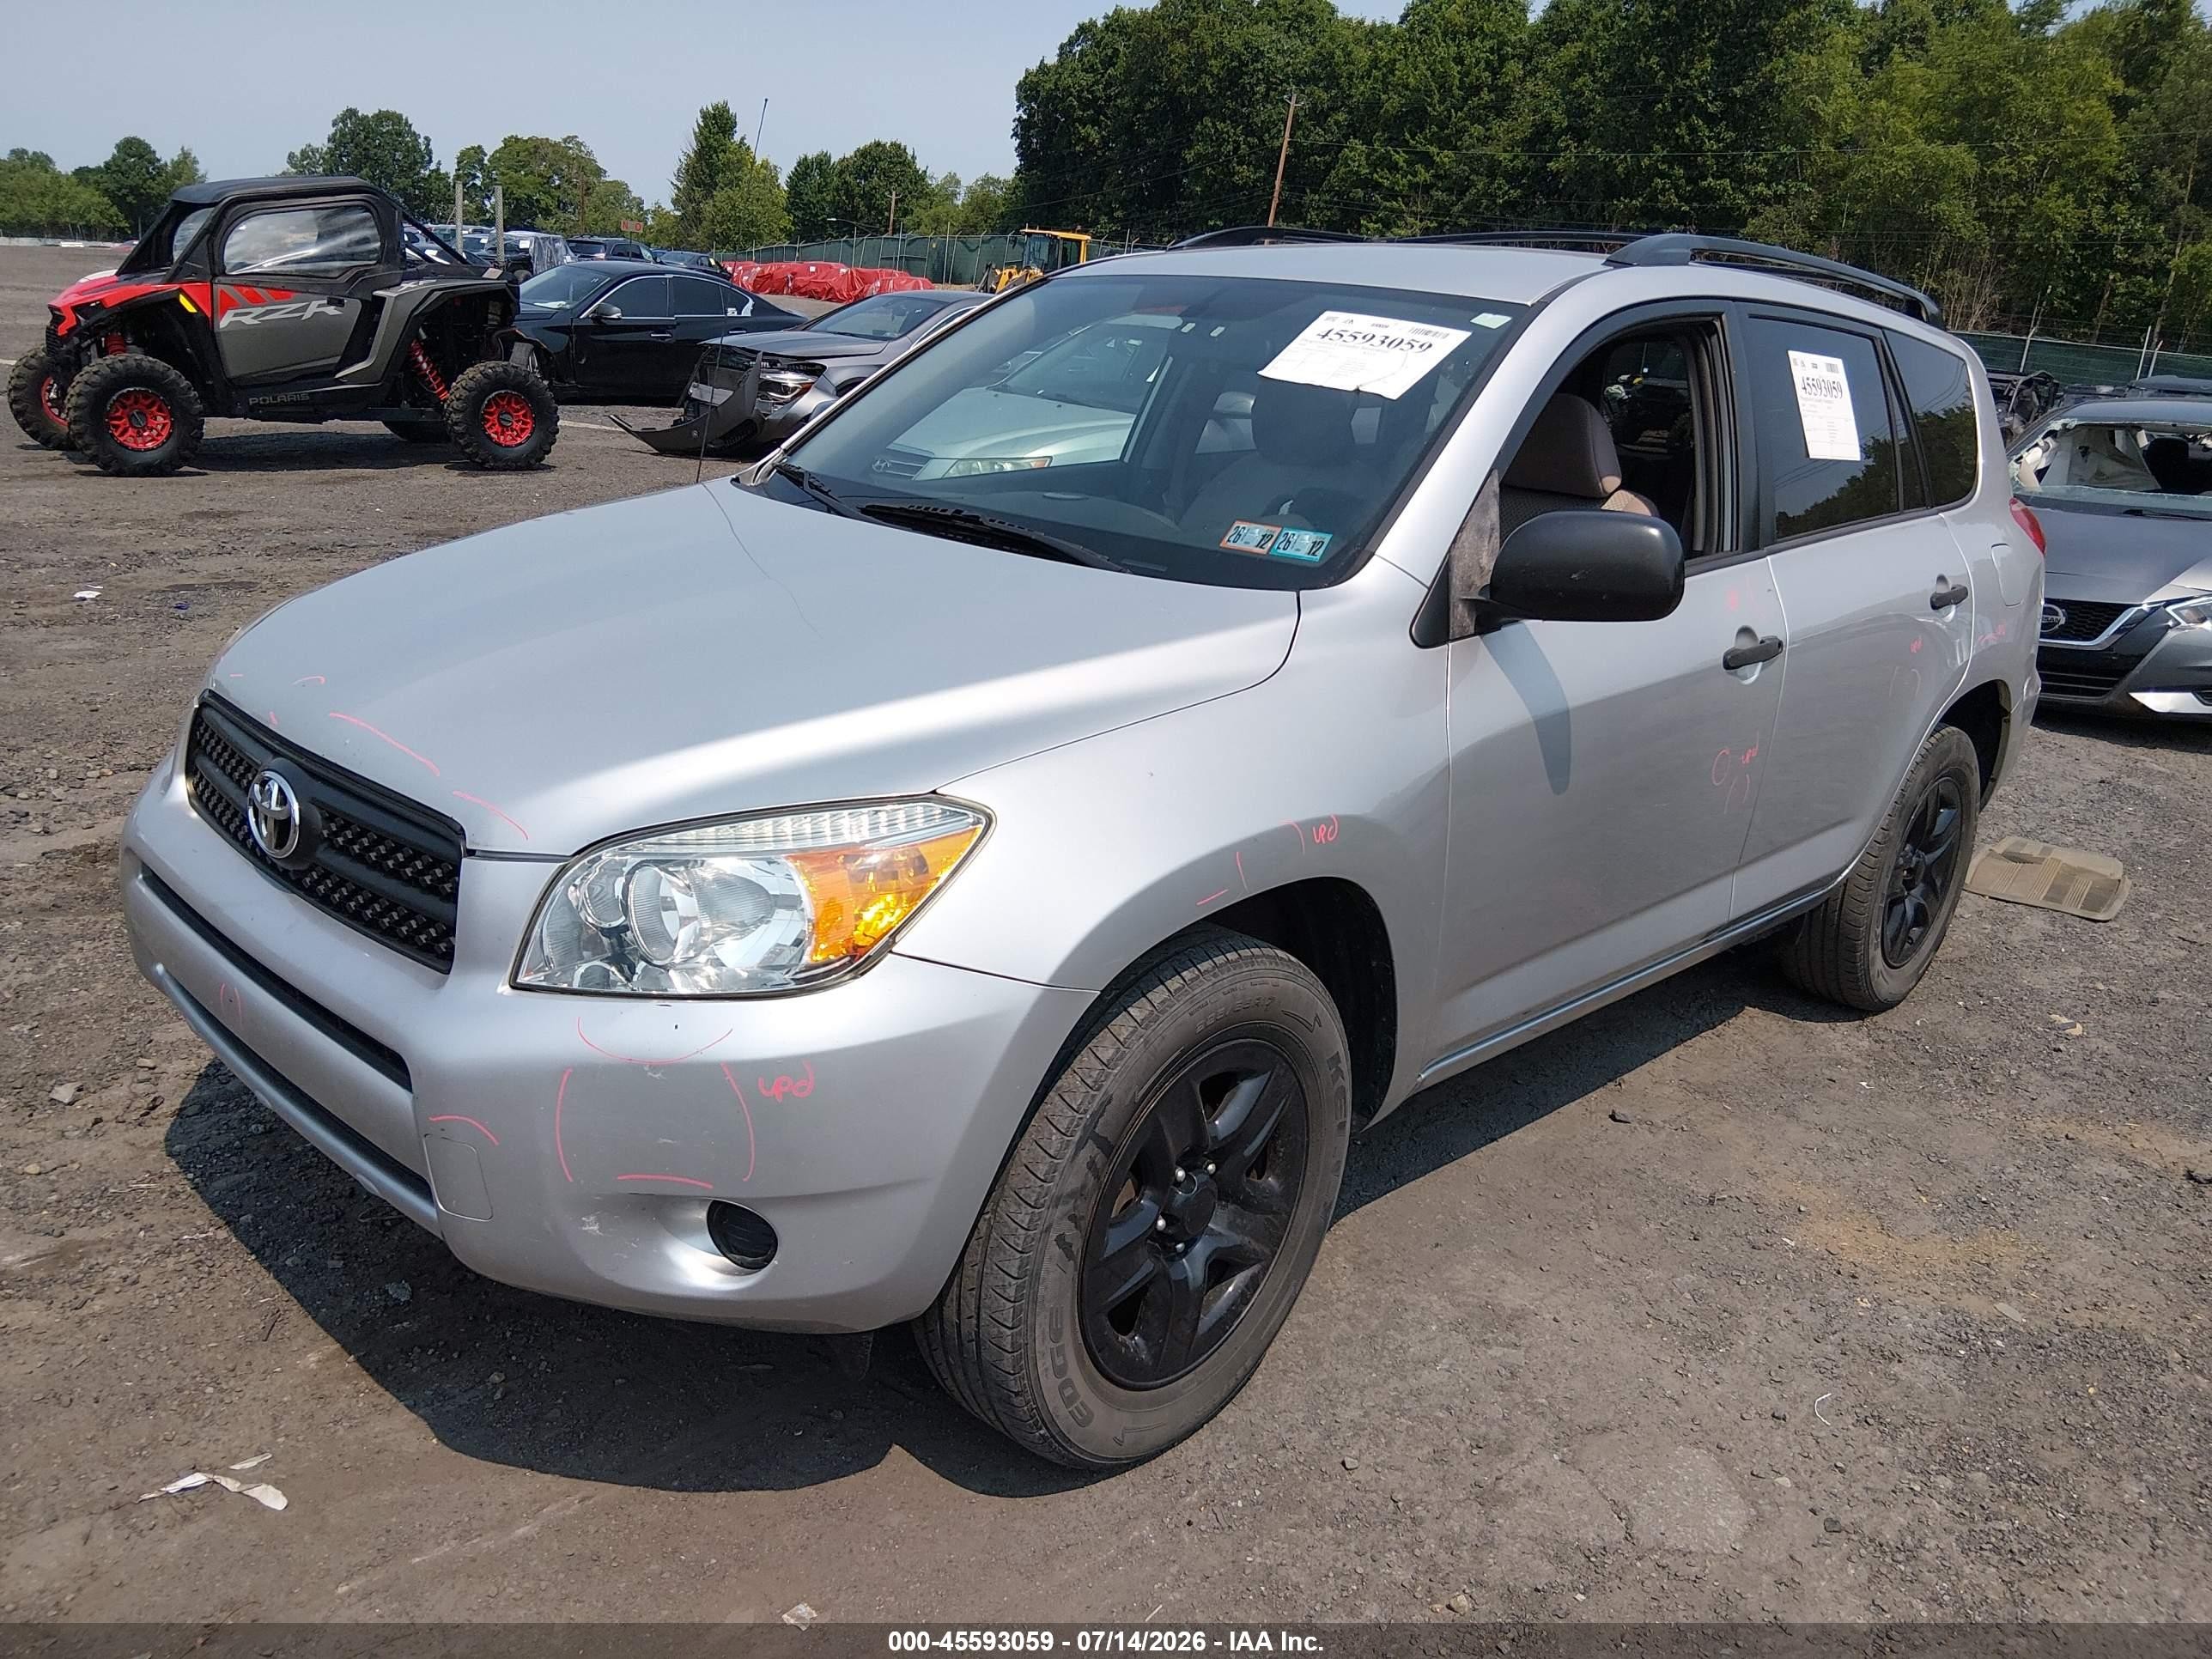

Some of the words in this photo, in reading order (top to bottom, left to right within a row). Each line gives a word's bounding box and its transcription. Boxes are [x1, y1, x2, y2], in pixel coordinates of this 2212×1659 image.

[219, 300, 345, 329] RZR
[1316, 327, 1434, 354] 45593059
[249, 392, 311, 406] POLARIS
[1801, 376, 1844, 399] 45593059
[1227, 525, 1247, 544] 26
[1255, 532, 1274, 550] 12
[1276, 532, 1297, 551] 26
[1308, 540, 1325, 557] 12
[1048, 1304, 1095, 1428] EDGE
